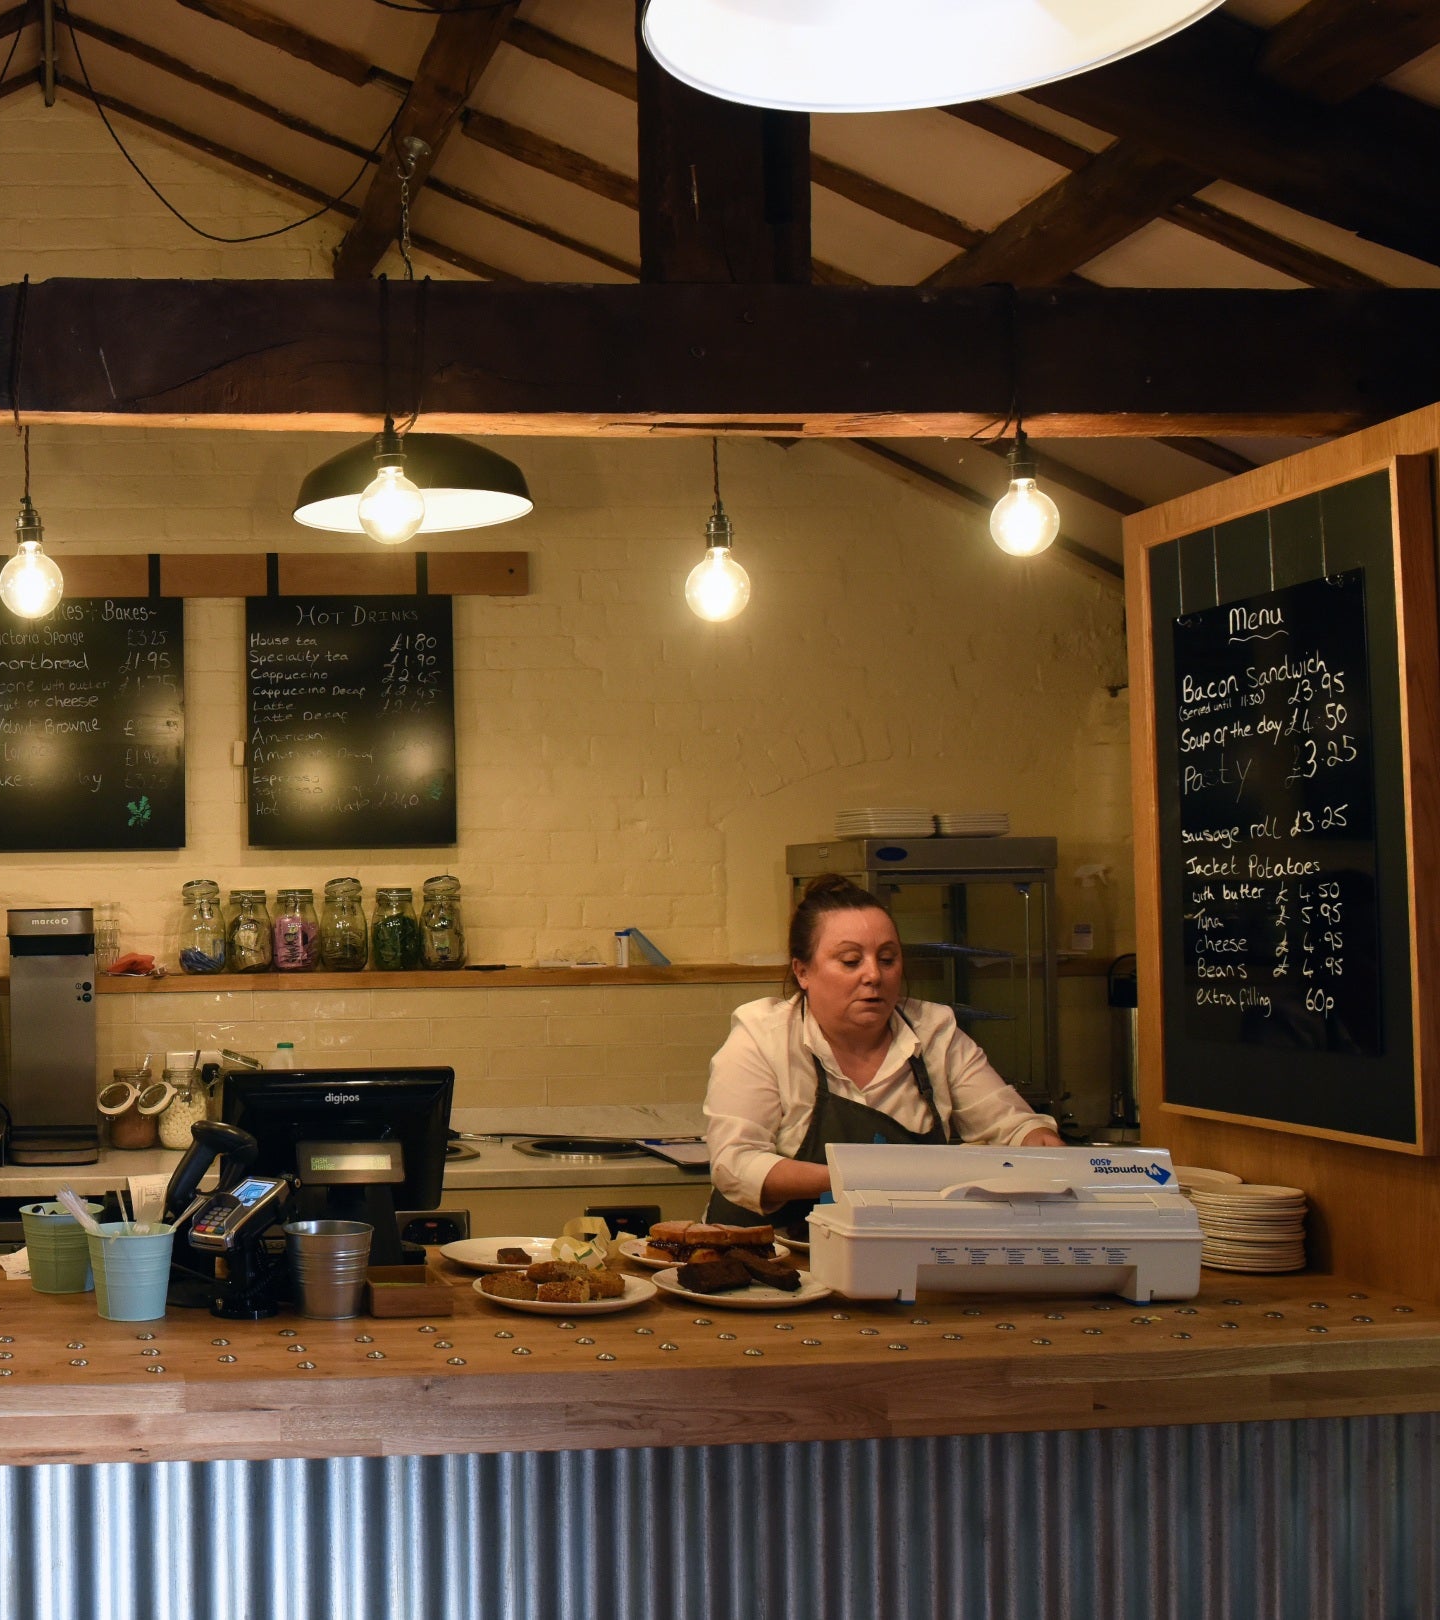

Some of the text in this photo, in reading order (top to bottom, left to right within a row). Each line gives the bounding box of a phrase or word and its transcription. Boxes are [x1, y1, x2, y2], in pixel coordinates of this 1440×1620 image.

[1229, 607, 1284, 635] Menu
[44, 626, 85, 646] Sponge
[250, 633, 289, 647] House
[296, 637, 318, 646] tea
[118, 651, 172, 673] £1.95
[249, 650, 320, 668] Speciality
[325, 650, 349, 661] tea
[250, 668, 328, 684] Cappuccino
[1183, 649, 1327, 703] Bacon Sandwich
[42, 680, 65, 691] with
[252, 686, 326, 698] Cappuccino
[332, 685, 366, 699] Decaf
[1288, 671, 1345, 705] £3.95
[27, 699, 40, 708] or
[45, 695, 99, 708] cheese
[253, 701, 296, 711] Latte
[1214, 698, 1232, 712] until
[44, 718, 101, 734] Brownie
[253, 711, 348, 724] Latte Decaf
[252, 728, 326, 744] Amrican
[1180, 728, 1211, 752] Soup
[1214, 725, 1228, 747] of
[1230, 720, 1254, 738] the
[1257, 714, 1283, 745] day
[252, 767, 320, 786] Esprsso
[1250, 815, 1282, 839] roll
[1290, 804, 1349, 837] £3.25
[1185, 854, 1321, 879] Jacket Potatoes
[1193, 886, 1215, 903] with
[1223, 883, 1265, 901] butter
[1193, 908, 1224, 931] Tuna
[1197, 957, 1248, 979] Beans
[1196, 986, 1334, 1019] extra filling 60p
[324, 1092, 360, 1105] digipos
[1090, 1158, 1111, 1166] 4500
